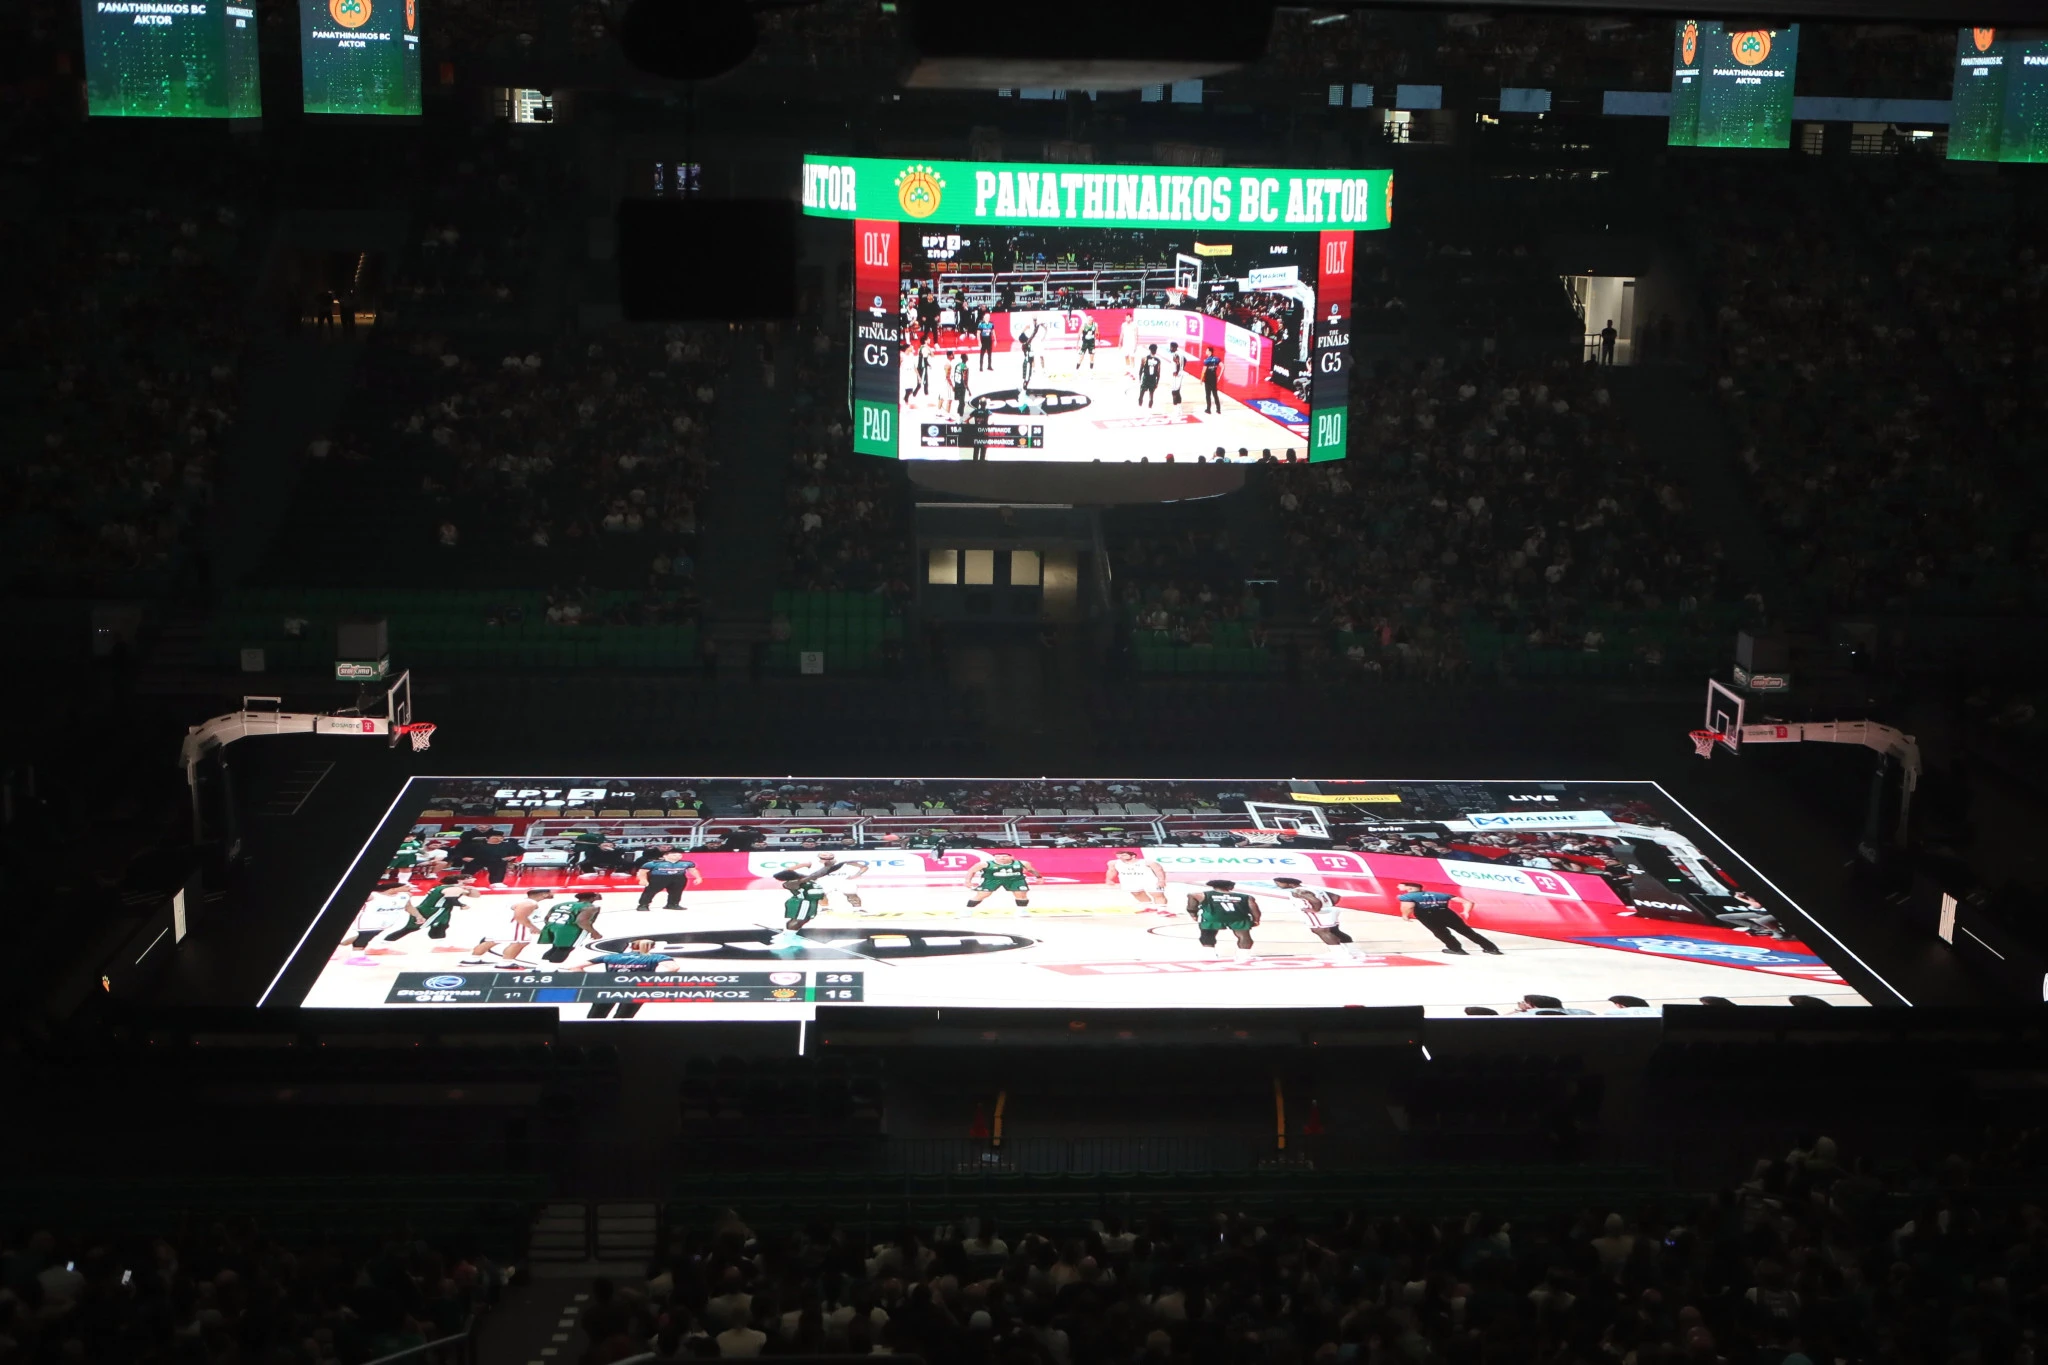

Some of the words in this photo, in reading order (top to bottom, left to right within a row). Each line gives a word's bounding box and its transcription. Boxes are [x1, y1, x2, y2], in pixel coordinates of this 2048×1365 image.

[97, 3, 189, 14] PANATHINAIKOS
[191, 5, 206, 14] BC
[133, 15, 172, 25] AKTOR
[312, 31, 378, 40] PANATHINAIKOS
[1713, 69, 1773, 77] PANATHINAIKOS
[975, 171, 1232, 223] PANATHINAIKOS
[1239, 177, 1279, 223] BC
[1285, 178, 1368, 223] AKTOR
[864, 231, 890, 267] OLY
[1270, 246, 1288, 254] LIVE
[1325, 241, 1347, 274] OLY
[872, 322, 884, 330] THE
[858, 326, 898, 341] FINALS
[1318, 333, 1349, 348] FINALS
[864, 344, 889, 366] G5
[1321, 352, 1341, 373] G5
[863, 407, 890, 442] PAO
[1317, 414, 1341, 447] PAO
[1508, 794, 1559, 802] LIVE
[1155, 855, 1297, 865] COSMOTE
[1450, 869, 1526, 884] COSMOTE
[1634, 899, 1693, 912] NOVA
[512, 975, 553, 983] 15.8
[614, 975, 740, 983] ΟΛΥΜΠΙΑΚΟΣ
[825, 974, 853, 983] 26
[597, 987, 750, 998] ΠΑΝΑΘΗΝΑΪΚΟΣ
[825, 990, 852, 998] 15
